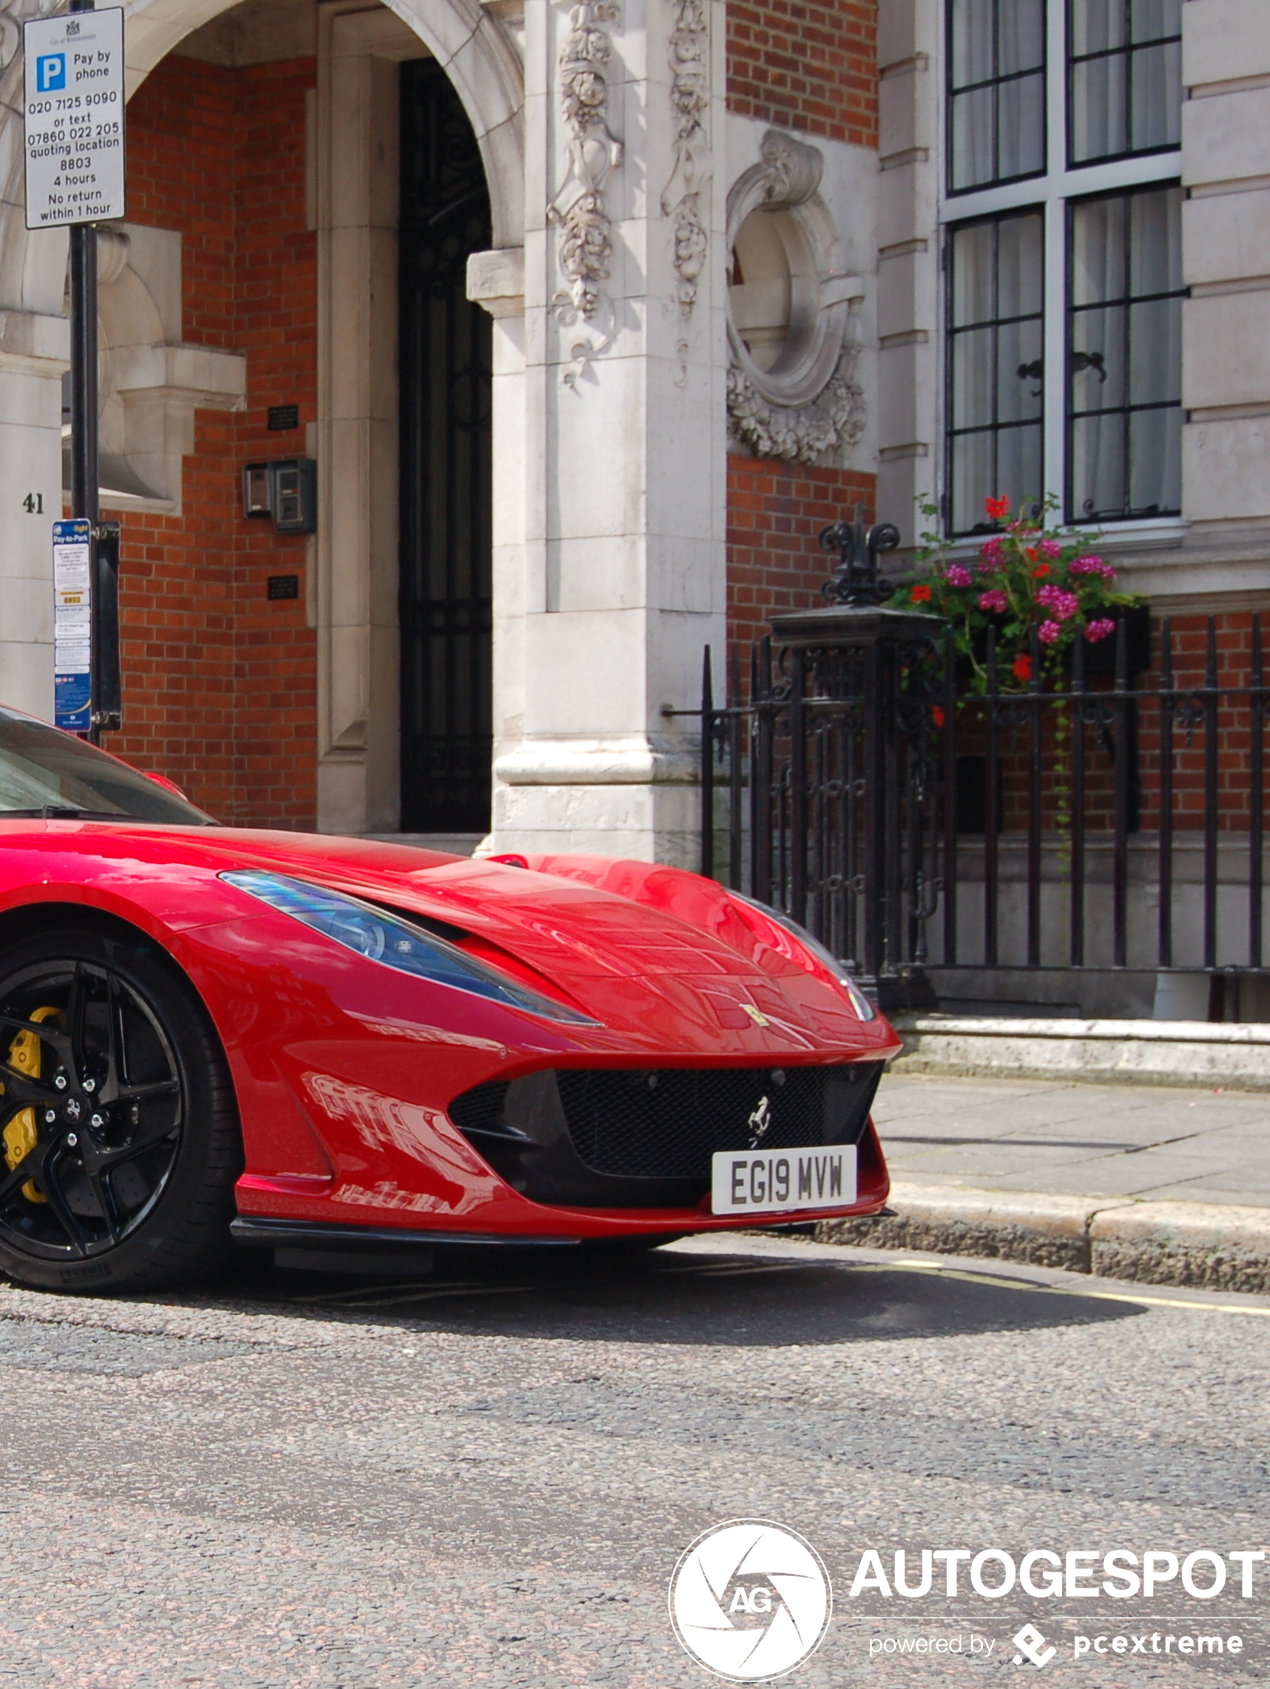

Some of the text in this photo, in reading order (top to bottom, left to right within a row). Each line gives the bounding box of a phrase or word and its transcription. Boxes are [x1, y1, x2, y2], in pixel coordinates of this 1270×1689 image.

[74, 50, 110, 65] Pay by
[43, 57, 61, 89] P
[75, 67, 109, 82] phone
[28, 91, 117, 114] 020 7125 9090
[54, 112, 91, 127] or text
[27, 122, 119, 146] 07860 022 205
[30, 138, 119, 159] quoting location
[60, 156, 91, 171] 8803
[53, 173, 96, 186] 4 hours
[48, 190, 102, 205] No return
[40, 204, 111, 221] within 1 hour
[22, 492, 44, 515] 41
[731, 1154, 843, 1205] EG19 MVW
